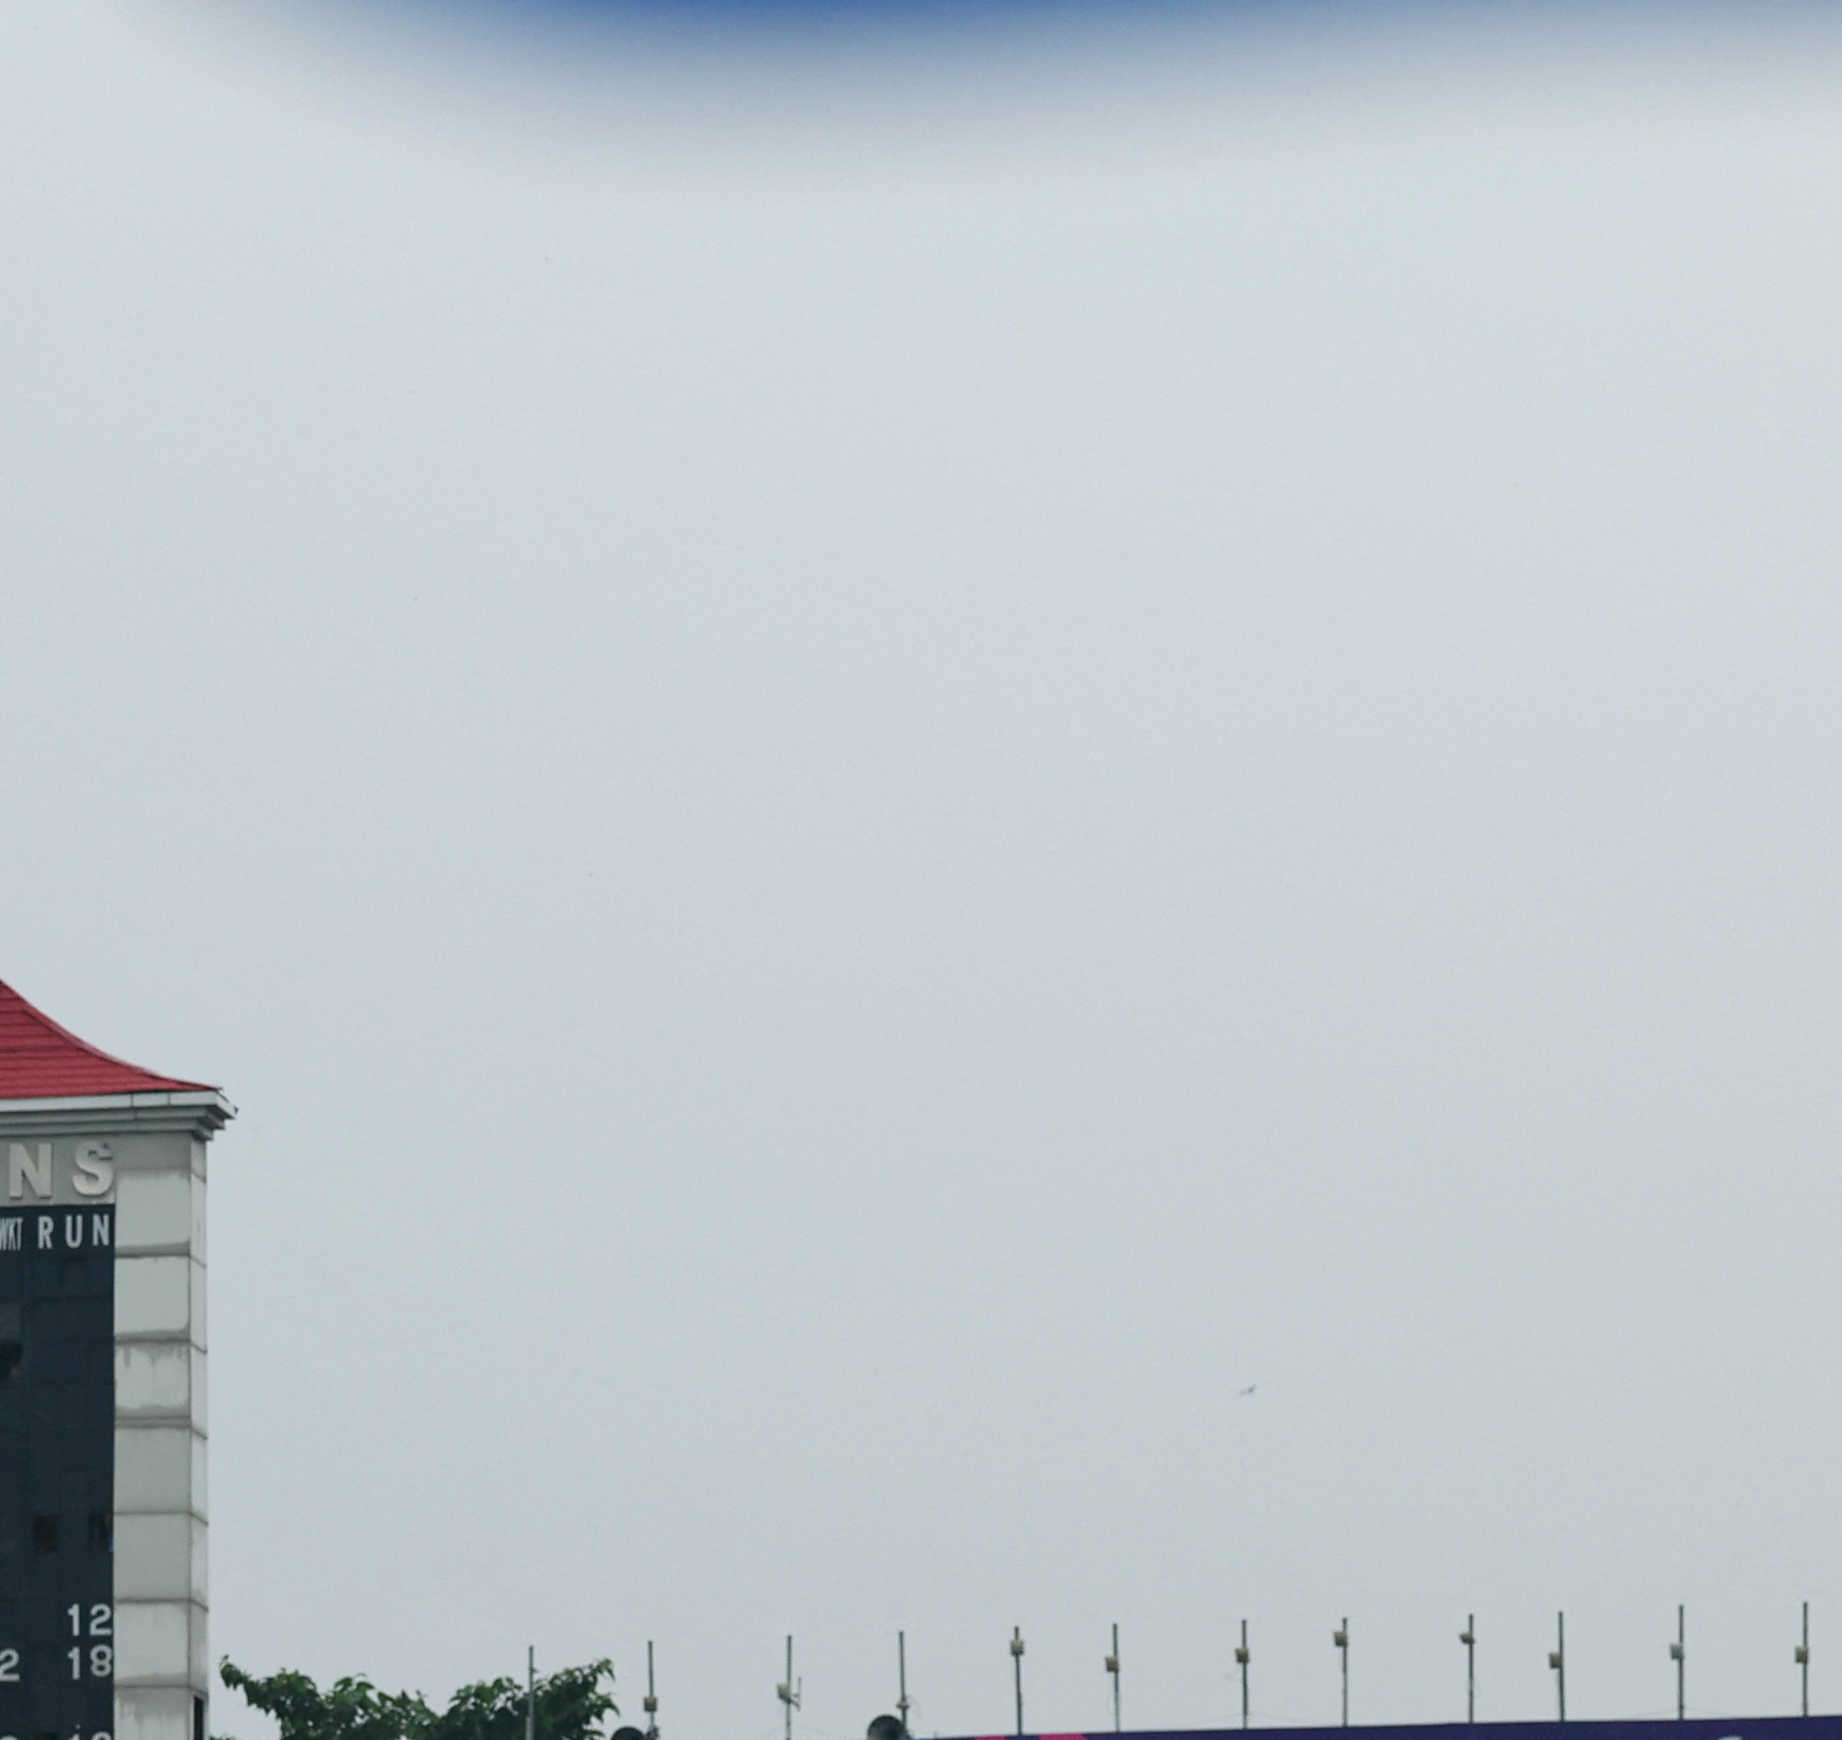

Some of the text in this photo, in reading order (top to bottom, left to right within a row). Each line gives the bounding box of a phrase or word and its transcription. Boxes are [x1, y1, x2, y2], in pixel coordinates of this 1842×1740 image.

[37, 1214, 110, 1250] RUN
[67, 1603, 113, 1637] 12
[67, 1644, 113, 1680] 18
